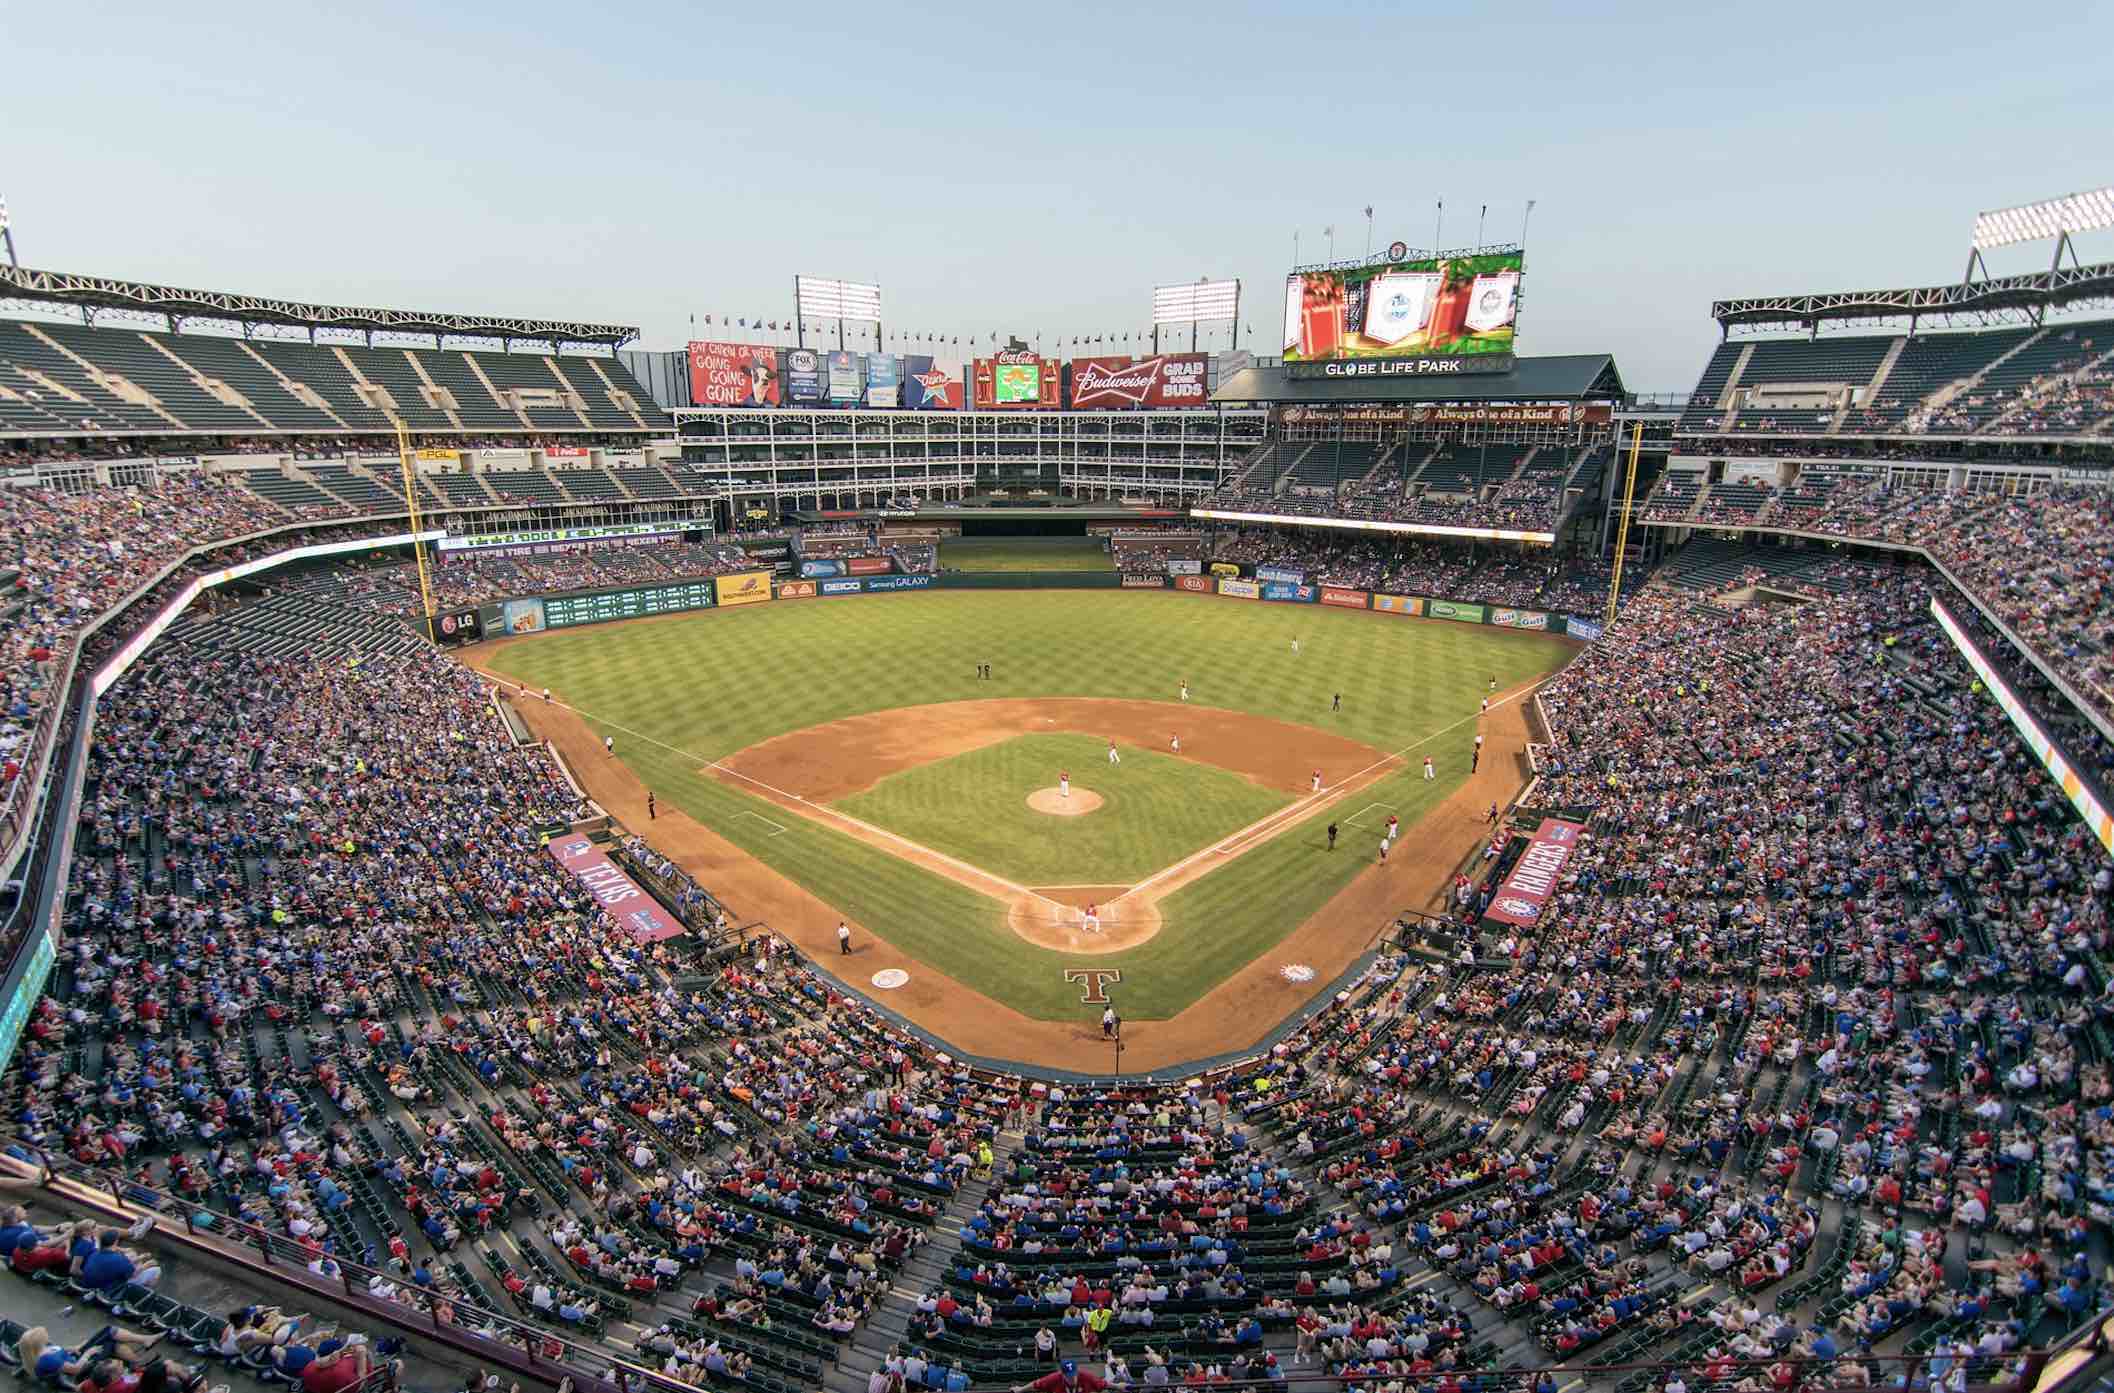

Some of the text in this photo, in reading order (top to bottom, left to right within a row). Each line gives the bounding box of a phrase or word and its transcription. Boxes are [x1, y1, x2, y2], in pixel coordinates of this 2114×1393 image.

[690, 343, 706, 353] EAT
[696, 356, 730, 370] GOING
[1163, 362, 1205, 376] GRAB
[1325, 359, 1461, 376] GLOBE LIFE PARK
[710, 370, 746, 386] GOING
[1076, 371, 1157, 391] Budweiser
[706, 385, 744, 401] GONE
[1162, 384, 1203, 397] BUDS
[1378, 409, 1404, 419] Kind
[1434, 409, 1475, 422] Always
[1521, 409, 1553, 420] Kind
[824, 582, 861, 592] GEICO
[895, 576, 929, 587] GALAXY
[457, 614, 474, 628] LG
[1508, 841, 1567, 896] RANGERS
[575, 862, 641, 903] TEXAS
[1064, 968, 1121, 1004] T
